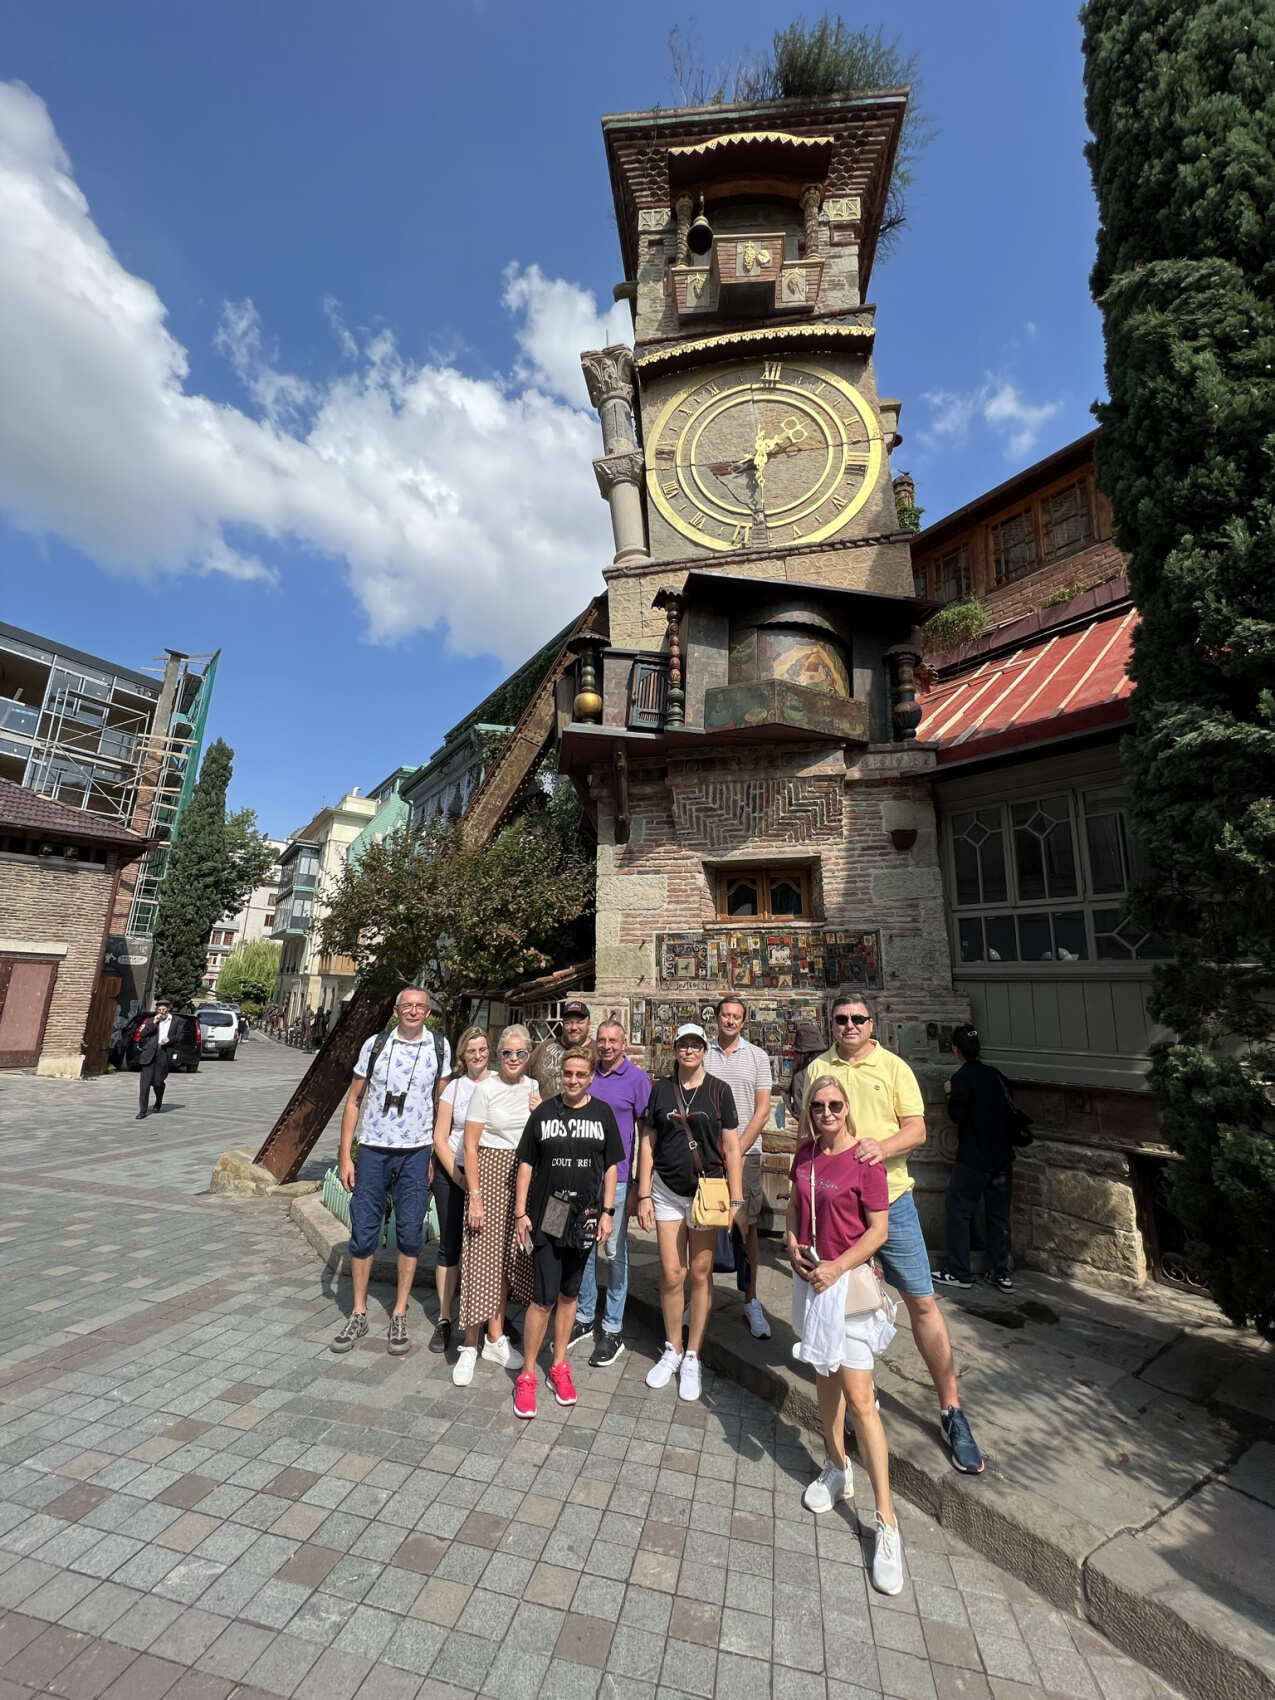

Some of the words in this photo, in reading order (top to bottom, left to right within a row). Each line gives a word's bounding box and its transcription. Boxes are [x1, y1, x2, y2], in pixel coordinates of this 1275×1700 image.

[761, 362, 783, 380] XII
[844, 415, 860, 426] II
[847, 451, 870, 466] III
[792, 525, 803, 538] V
[541, 1119, 605, 1141] MOSCHINO
[551, 1158, 592, 1168] COUTRE!
